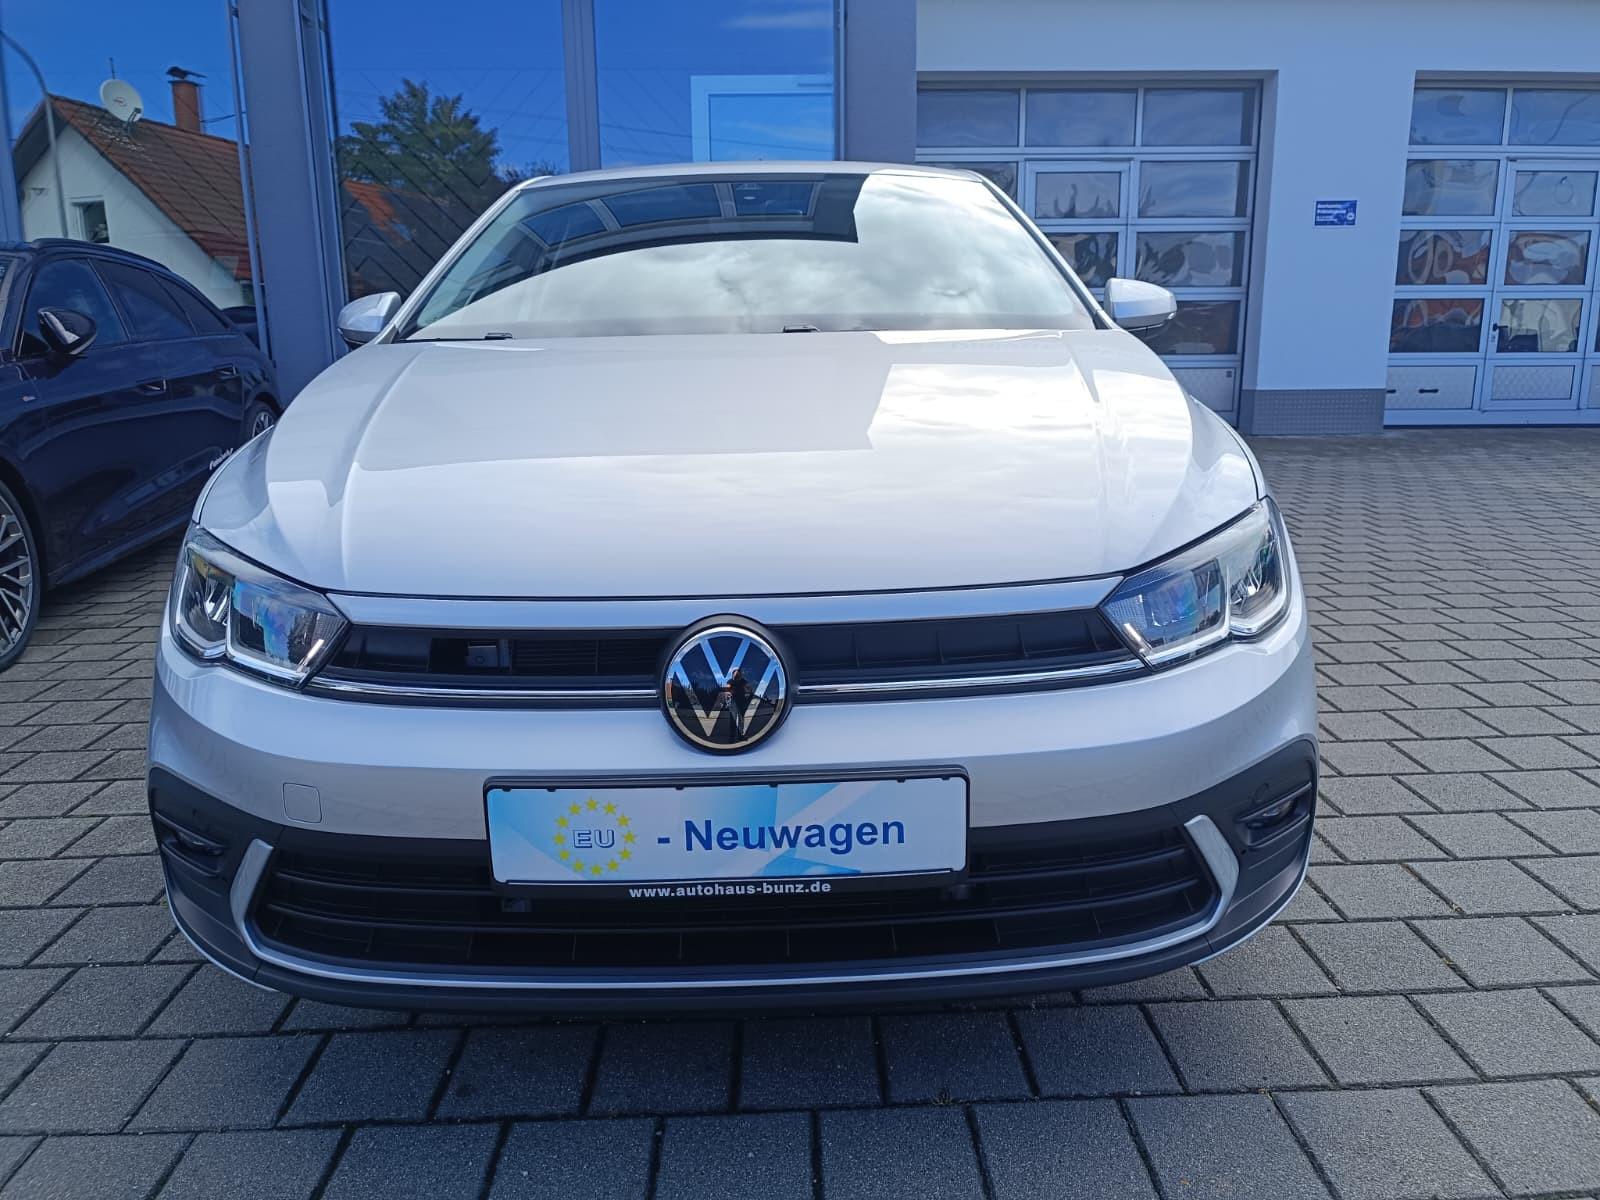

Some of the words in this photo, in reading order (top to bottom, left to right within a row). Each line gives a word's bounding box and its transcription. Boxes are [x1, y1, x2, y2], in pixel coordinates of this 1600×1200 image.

[667, 633, 785, 744] VW
[573, 829, 615, 849] EU
[684, 820, 905, 855] Neuwagen
[629, 881, 832, 898] www.autohaus-bunz.de
